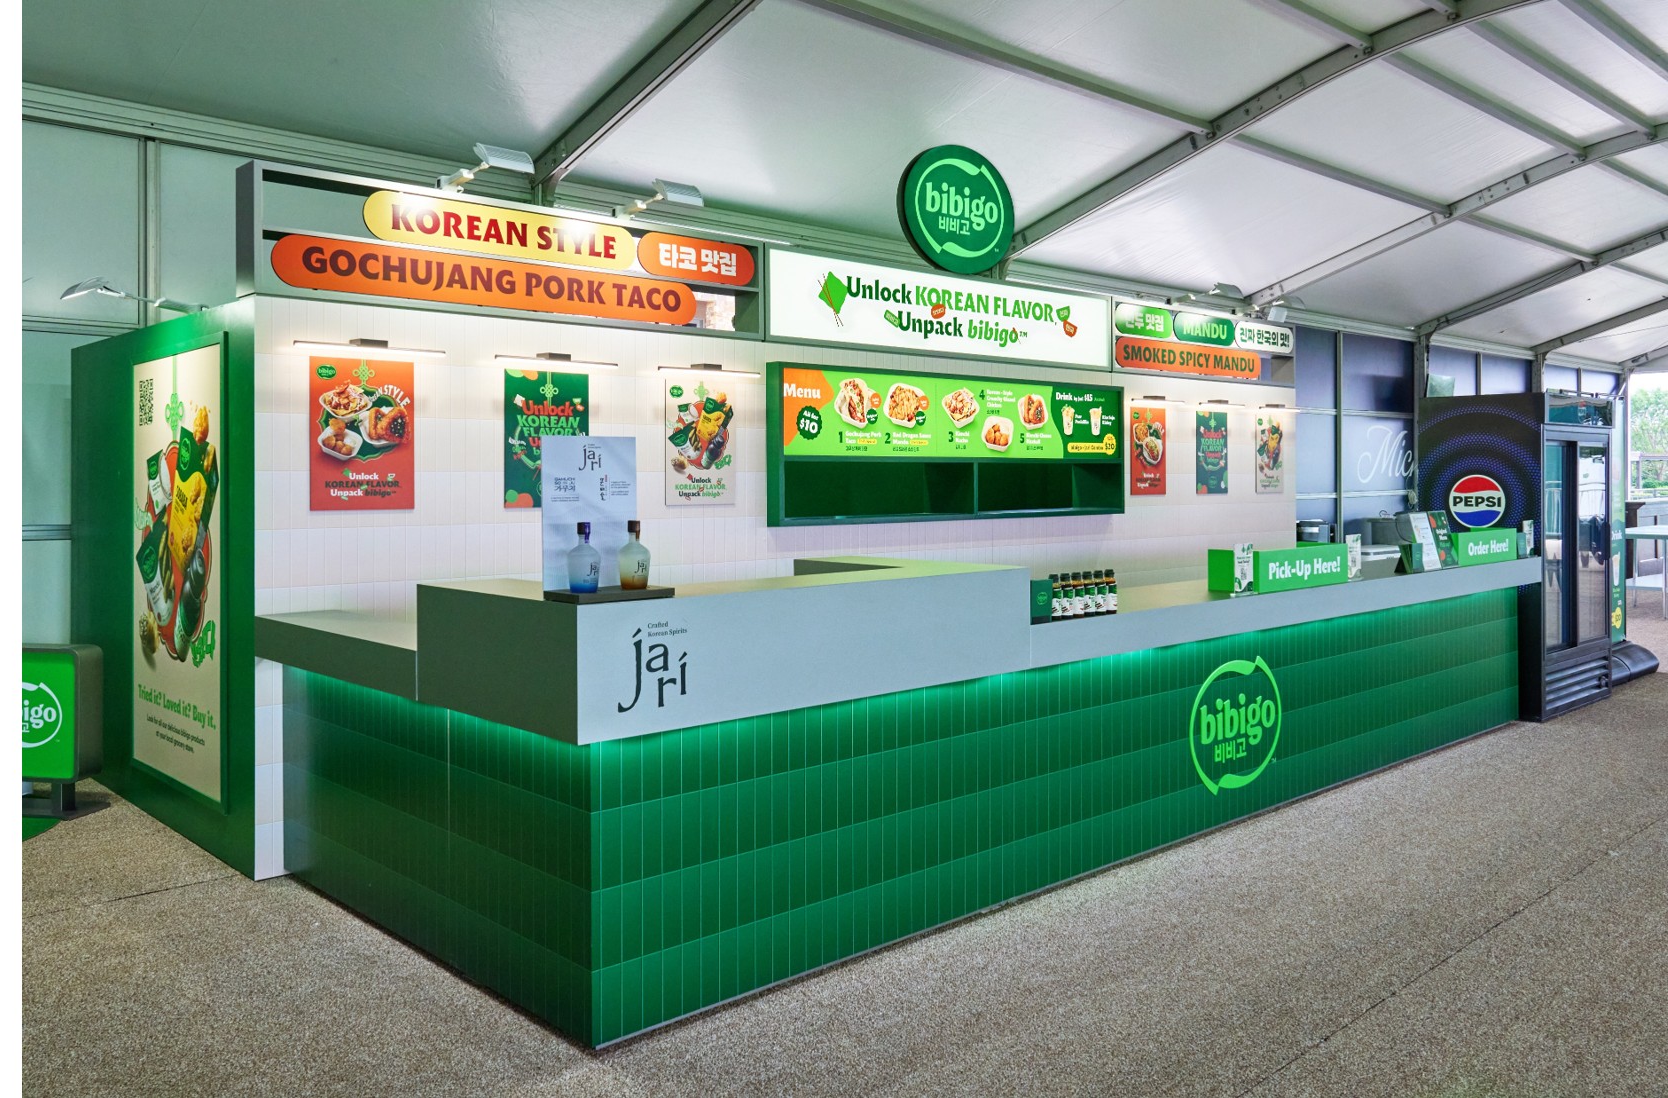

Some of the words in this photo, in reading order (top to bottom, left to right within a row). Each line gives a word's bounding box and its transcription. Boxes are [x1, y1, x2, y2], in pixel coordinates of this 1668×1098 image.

[925, 181, 998, 231] bibigo
[392, 204, 528, 247] KOREAN
[537, 225, 616, 259] STYLE
[938, 216, 971, 235] 비비고
[658, 242, 698, 271] 타코
[701, 250, 737, 277] 맛집
[302, 246, 517, 295] GOCHUJANG
[525, 272, 606, 305] PORK
[612, 283, 681, 313] TACO
[846, 275, 913, 305] Unlock
[915, 285, 990, 314] KOREAN
[898, 310, 963, 339] Unpack
[1145, 313, 1164, 332] 맛집
[1183, 320, 1227, 340] MANDU
[1239, 327, 1255, 343] 진짜
[1257, 329, 1279, 346] 한국의
[1123, 344, 1177, 365] SMOKED
[1179, 351, 1211, 368] SPICY
[1213, 354, 1255, 373] MANDU
[384, 384, 411, 408] STYLE
[784, 383, 821, 399] Menu
[979, 390, 985, 400] 4
[1056, 392, 1072, 400] Drink
[521, 400, 574, 416] Unlock
[517, 415, 580, 428] KOREAN
[800, 418, 818, 434] $10
[523, 427, 573, 436] FLAVOR
[839, 431, 843, 443] 1
[885, 433, 891, 444] 2
[948, 431, 954, 442] 3
[1020, 433, 1025, 443] 5
[349, 472, 379, 480] Unlock
[330, 489, 363, 497] Unpack
[1453, 496, 1501, 507] PEPSI
[1468, 541, 1489, 556] Order
[1490, 539, 1509, 553] Here!
[1269, 560, 1311, 580] Pick-Up
[1314, 556, 1340, 574] Here!
[648, 621, 668, 629] Crafted
[669, 628, 687, 636] Spirits
[138, 684, 153, 703] Tried
[154, 689, 162, 706] it?
[163, 693, 181, 715] Loved
[182, 700, 191, 718] it?
[193, 705, 207, 729] Buy
[207, 710, 216, 730] it.
[1200, 693, 1275, 745] bibigo
[1214, 738, 1246, 763] 비비고
